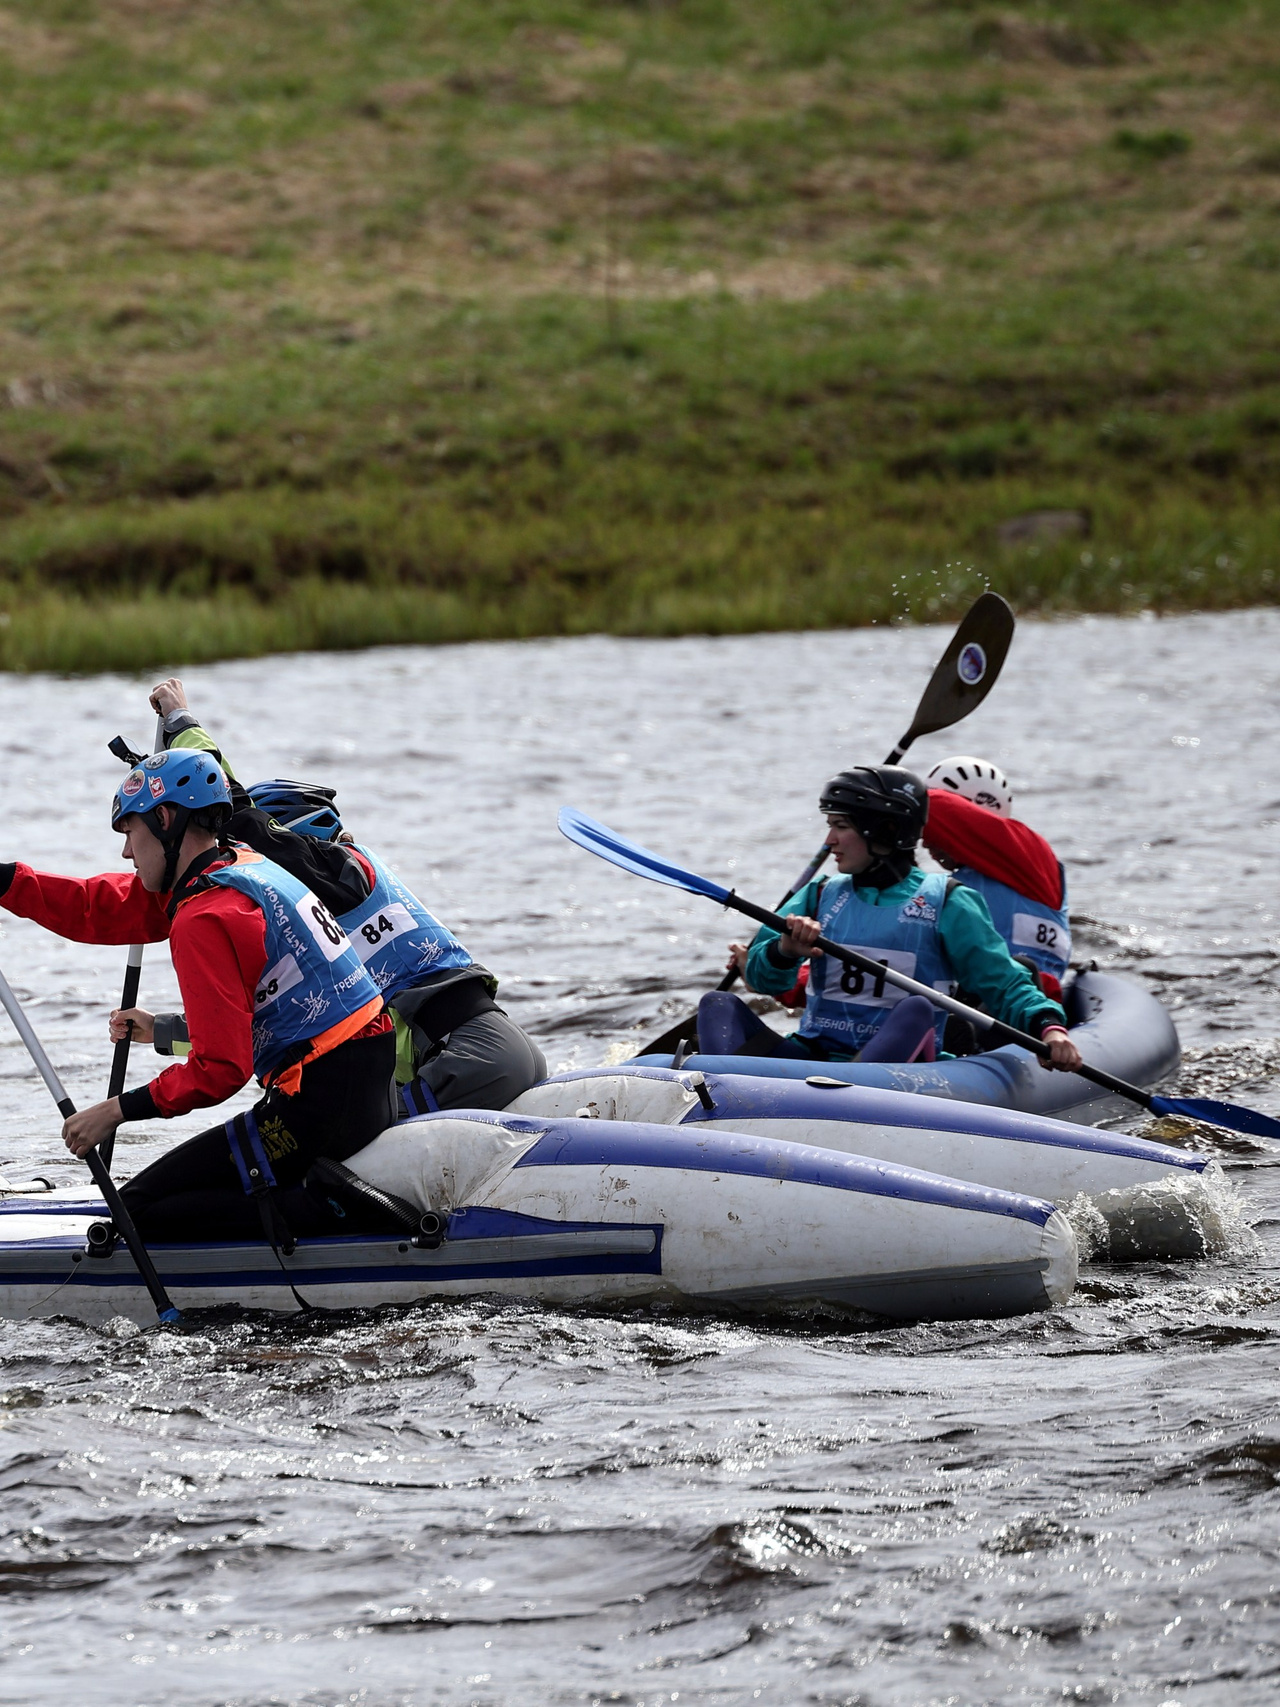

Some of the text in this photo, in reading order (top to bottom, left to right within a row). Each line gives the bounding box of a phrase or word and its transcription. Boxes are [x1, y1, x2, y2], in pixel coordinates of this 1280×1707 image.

[360, 913, 395, 945] 84
[1035, 923, 1058, 949] 82
[840, 958, 889, 998] 81
